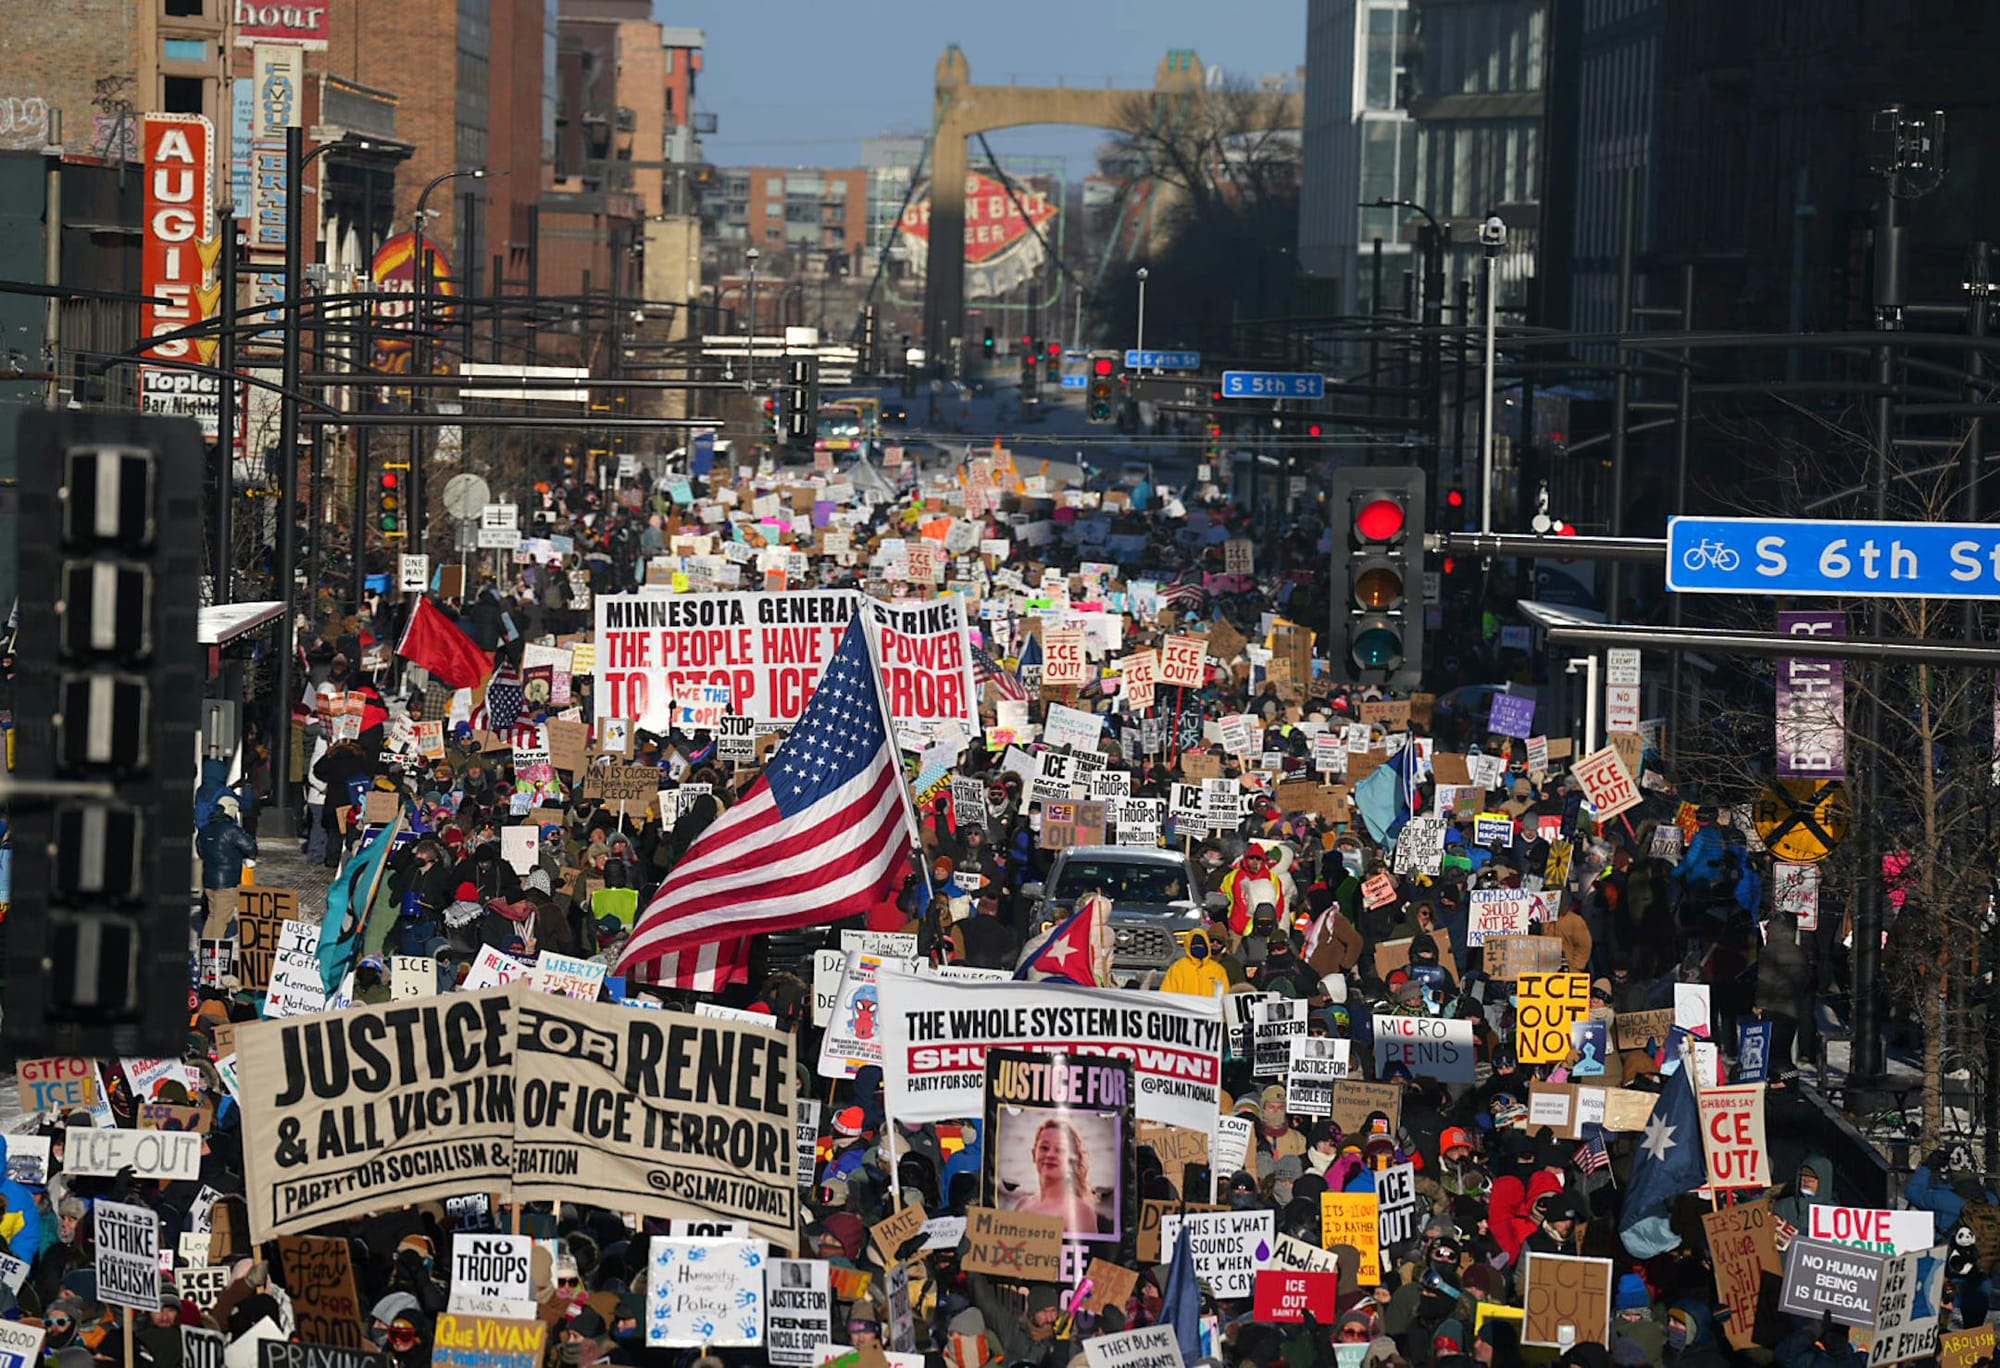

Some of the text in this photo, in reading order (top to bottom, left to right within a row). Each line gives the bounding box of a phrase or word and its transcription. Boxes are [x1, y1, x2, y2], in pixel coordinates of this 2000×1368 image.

[989, 186, 1047, 219] BELT
[964, 222, 1004, 244] EER
[1231, 377, 1316, 393] S 5th St
[404, 557, 425, 577] ONE WAY
[1755, 536, 1788, 577] S
[1819, 538, 1919, 580] 6th
[606, 599, 744, 628] MINNESOTA
[874, 602, 959, 635] STRIKE:
[605, 631, 652, 668] THE
[661, 627, 754, 668] PEOPLE
[762, 627, 824, 665] HAVE
[881, 632, 962, 671] POWER
[1047, 644, 1079, 660] ICE
[1166, 647, 1199, 667] ICE
[1046, 661, 1080, 678] OUT!
[1126, 666, 1152, 684] ICE
[1163, 663, 1200, 684] OUT!
[605, 671, 648, 722] TO
[677, 687, 730, 704] WE THE
[1616, 692, 1630, 702] NO
[719, 716, 754, 737] STOP
[719, 748, 752, 756] NOW!
[730, 739, 753, 748] TERROR
[1042, 753, 1068, 779] ICE
[1100, 774, 1121, 782] NO
[1583, 763, 1623, 794] ICE
[954, 787, 982, 801] STRIKE
[1032, 785, 1069, 799] MINNESOTA
[1093, 781, 1129, 797] TROOPS
[1179, 784, 1203, 807] ICE
[1593, 784, 1633, 811] OUT!
[1125, 800, 1147, 809] NO
[1119, 808, 1155, 823] TROOPS
[1049, 825, 1091, 848] OUT
[1118, 831, 1155, 842] MINNESOTA
[1479, 822, 1510, 832] DEPORT
[239, 892, 291, 919] ICE
[1481, 904, 1519, 917] SHOULD
[286, 922, 313, 937] USES
[1478, 916, 1519, 930] NOT BE
[399, 958, 429, 973] ICE
[545, 958, 604, 980] LIBERTY
[544, 973, 597, 993] JUSTICE
[1519, 974, 1589, 1000] ICE
[1519, 1004, 1586, 1029] OUT
[906, 1007, 1223, 1051] THE WHOLE SYSTEM IS GUILTY!
[1255, 1020, 1307, 1038] JUSTICE FOR
[1381, 1018, 1447, 1039] MICRO
[275, 996, 789, 1117] JUSTICE FOR RENEE
[1256, 1050, 1282, 1065] NICOLE
[1385, 1040, 1460, 1065] PENIS
[22, 1057, 87, 1080] GTFO
[1291, 1057, 1347, 1076] JUSTICE FOR
[907, 1076, 1217, 1104] PARTY FOR @PSLNATIONAL
[993, 1060, 1128, 1106] JUSTICE FOR
[29, 1076, 93, 1112] ICE!
[1290, 1089, 1319, 1103] NICOLE
[1738, 1099, 1755, 1109] SAY
[275, 1075, 791, 1176] & ALL VICTIM OF ICE TERROR!
[1227, 1118, 1249, 1131] OUT
[70, 1132, 198, 1174] ICE OUT
[284, 1142, 788, 1217] PARTY FOR SOCIALISM & @PSLNATIONAL
[1379, 1171, 1408, 1208] ICE
[98, 1208, 154, 1228] JAN.23
[880, 1213, 918, 1240] HATE
[976, 1213, 1056, 1240] Minnesota
[1215, 1215, 1270, 1233] IS WHAT
[1344, 1220, 1376, 1233] RATHER
[1379, 1206, 1415, 1247] OUT
[1813, 1206, 1893, 1242] LOVE
[99, 1219, 154, 1259] STRIKE
[472, 1240, 514, 1255] NO
[1191, 1237, 1244, 1254] SOUNDS
[102, 1253, 152, 1272] AGAINST
[1216, 1256, 1253, 1270] WHEN
[1273, 1239, 1331, 1273] Abolish
[458, 1255, 528, 1284] TROOPS
[1529, 1261, 1604, 1291] ICE
[1802, 1254, 1878, 1281] NO HUMAN
[1888, 1259, 1906, 1274] THE
[100, 1260, 156, 1298] RACISM
[182, 1272, 224, 1290] ICE
[678, 1264, 737, 1290] Humanity
[1228, 1274, 1255, 1291] CRY
[1285, 1279, 1306, 1293] ICE
[1815, 1273, 1858, 1293] BEING
[1884, 1274, 1905, 1292] NEW
[481, 1286, 499, 1297] IN
[769, 1289, 827, 1311] JUSTICE FOR
[1281, 1294, 1308, 1308] OUT
[1795, 1284, 1872, 1313] IS ILLEGAL
[677, 1294, 729, 1319] Policy
[1272, 1308, 1293, 1318] SAINT
[1527, 1289, 1605, 1319] OUT
[770, 1316, 828, 1330] RENEE
[770, 1331, 801, 1349] NICOLE
[1098, 1331, 1171, 1359] THEY BLAME
[1872, 1335, 1895, 1360] OF
[1943, 1332, 1995, 1356] ABOLISH
